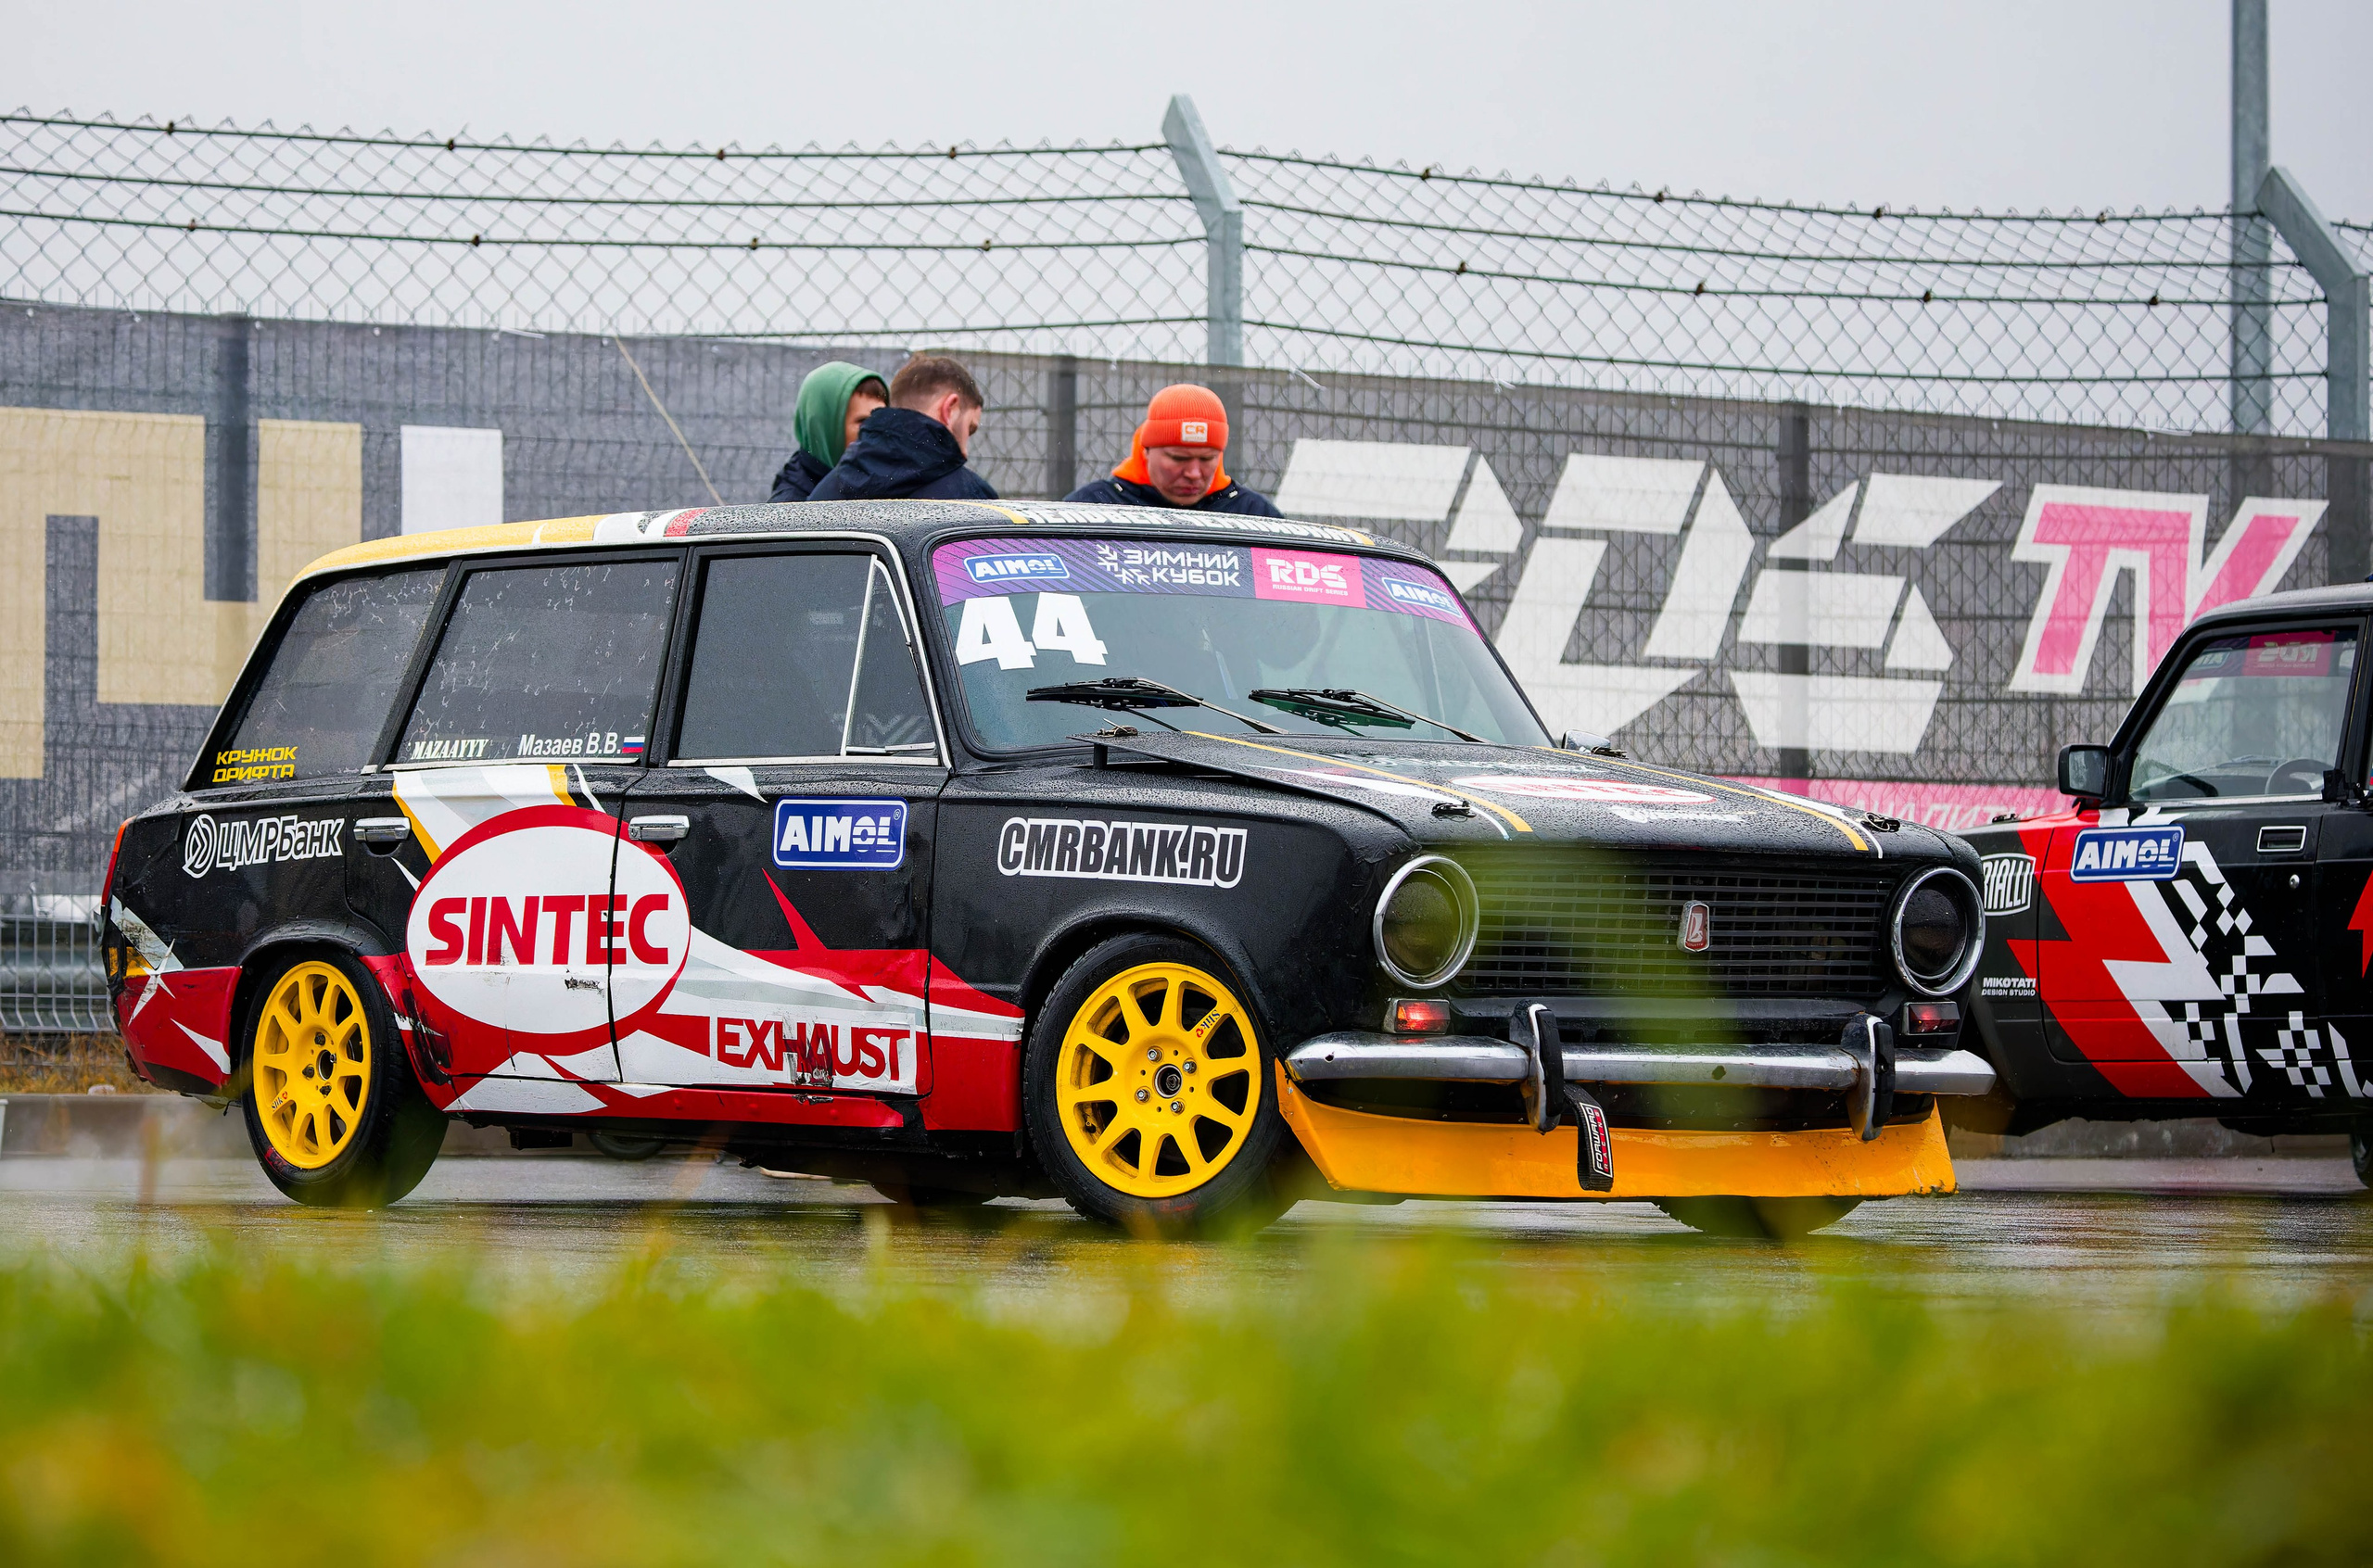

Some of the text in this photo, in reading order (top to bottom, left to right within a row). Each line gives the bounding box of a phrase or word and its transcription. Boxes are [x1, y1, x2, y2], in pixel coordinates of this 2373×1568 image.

[1123, 549, 1239, 570] ЗИМНИЙ
[1152, 567, 1240, 587] КУБОК
[1266, 558, 1347, 588] RDS
[2009, 483, 2329, 697] TV
[955, 591, 1109, 671] 44
[215, 746, 298, 765] КРУЖОК
[517, 732, 622, 756] Мазаев В.В.
[212, 764, 295, 782] ДРИФТА
[215, 814, 346, 872] ЦМРБанк
[779, 814, 897, 855] AIMOL
[997, 816, 1248, 889] CMRBANK.RU
[2077, 839, 2175, 869] AIMOL
[1983, 858, 2032, 910] RIALLI
[425, 893, 670, 967] SINTEC
[1981, 988, 2036, 996] DESIGN STUDIO
[1982, 977, 2037, 989] MIKOTATI
[717, 1016, 913, 1081] EXHAUST
[1585, 1106, 1604, 1170] FORWARD
[1594, 1110, 1609, 1170] RACING
